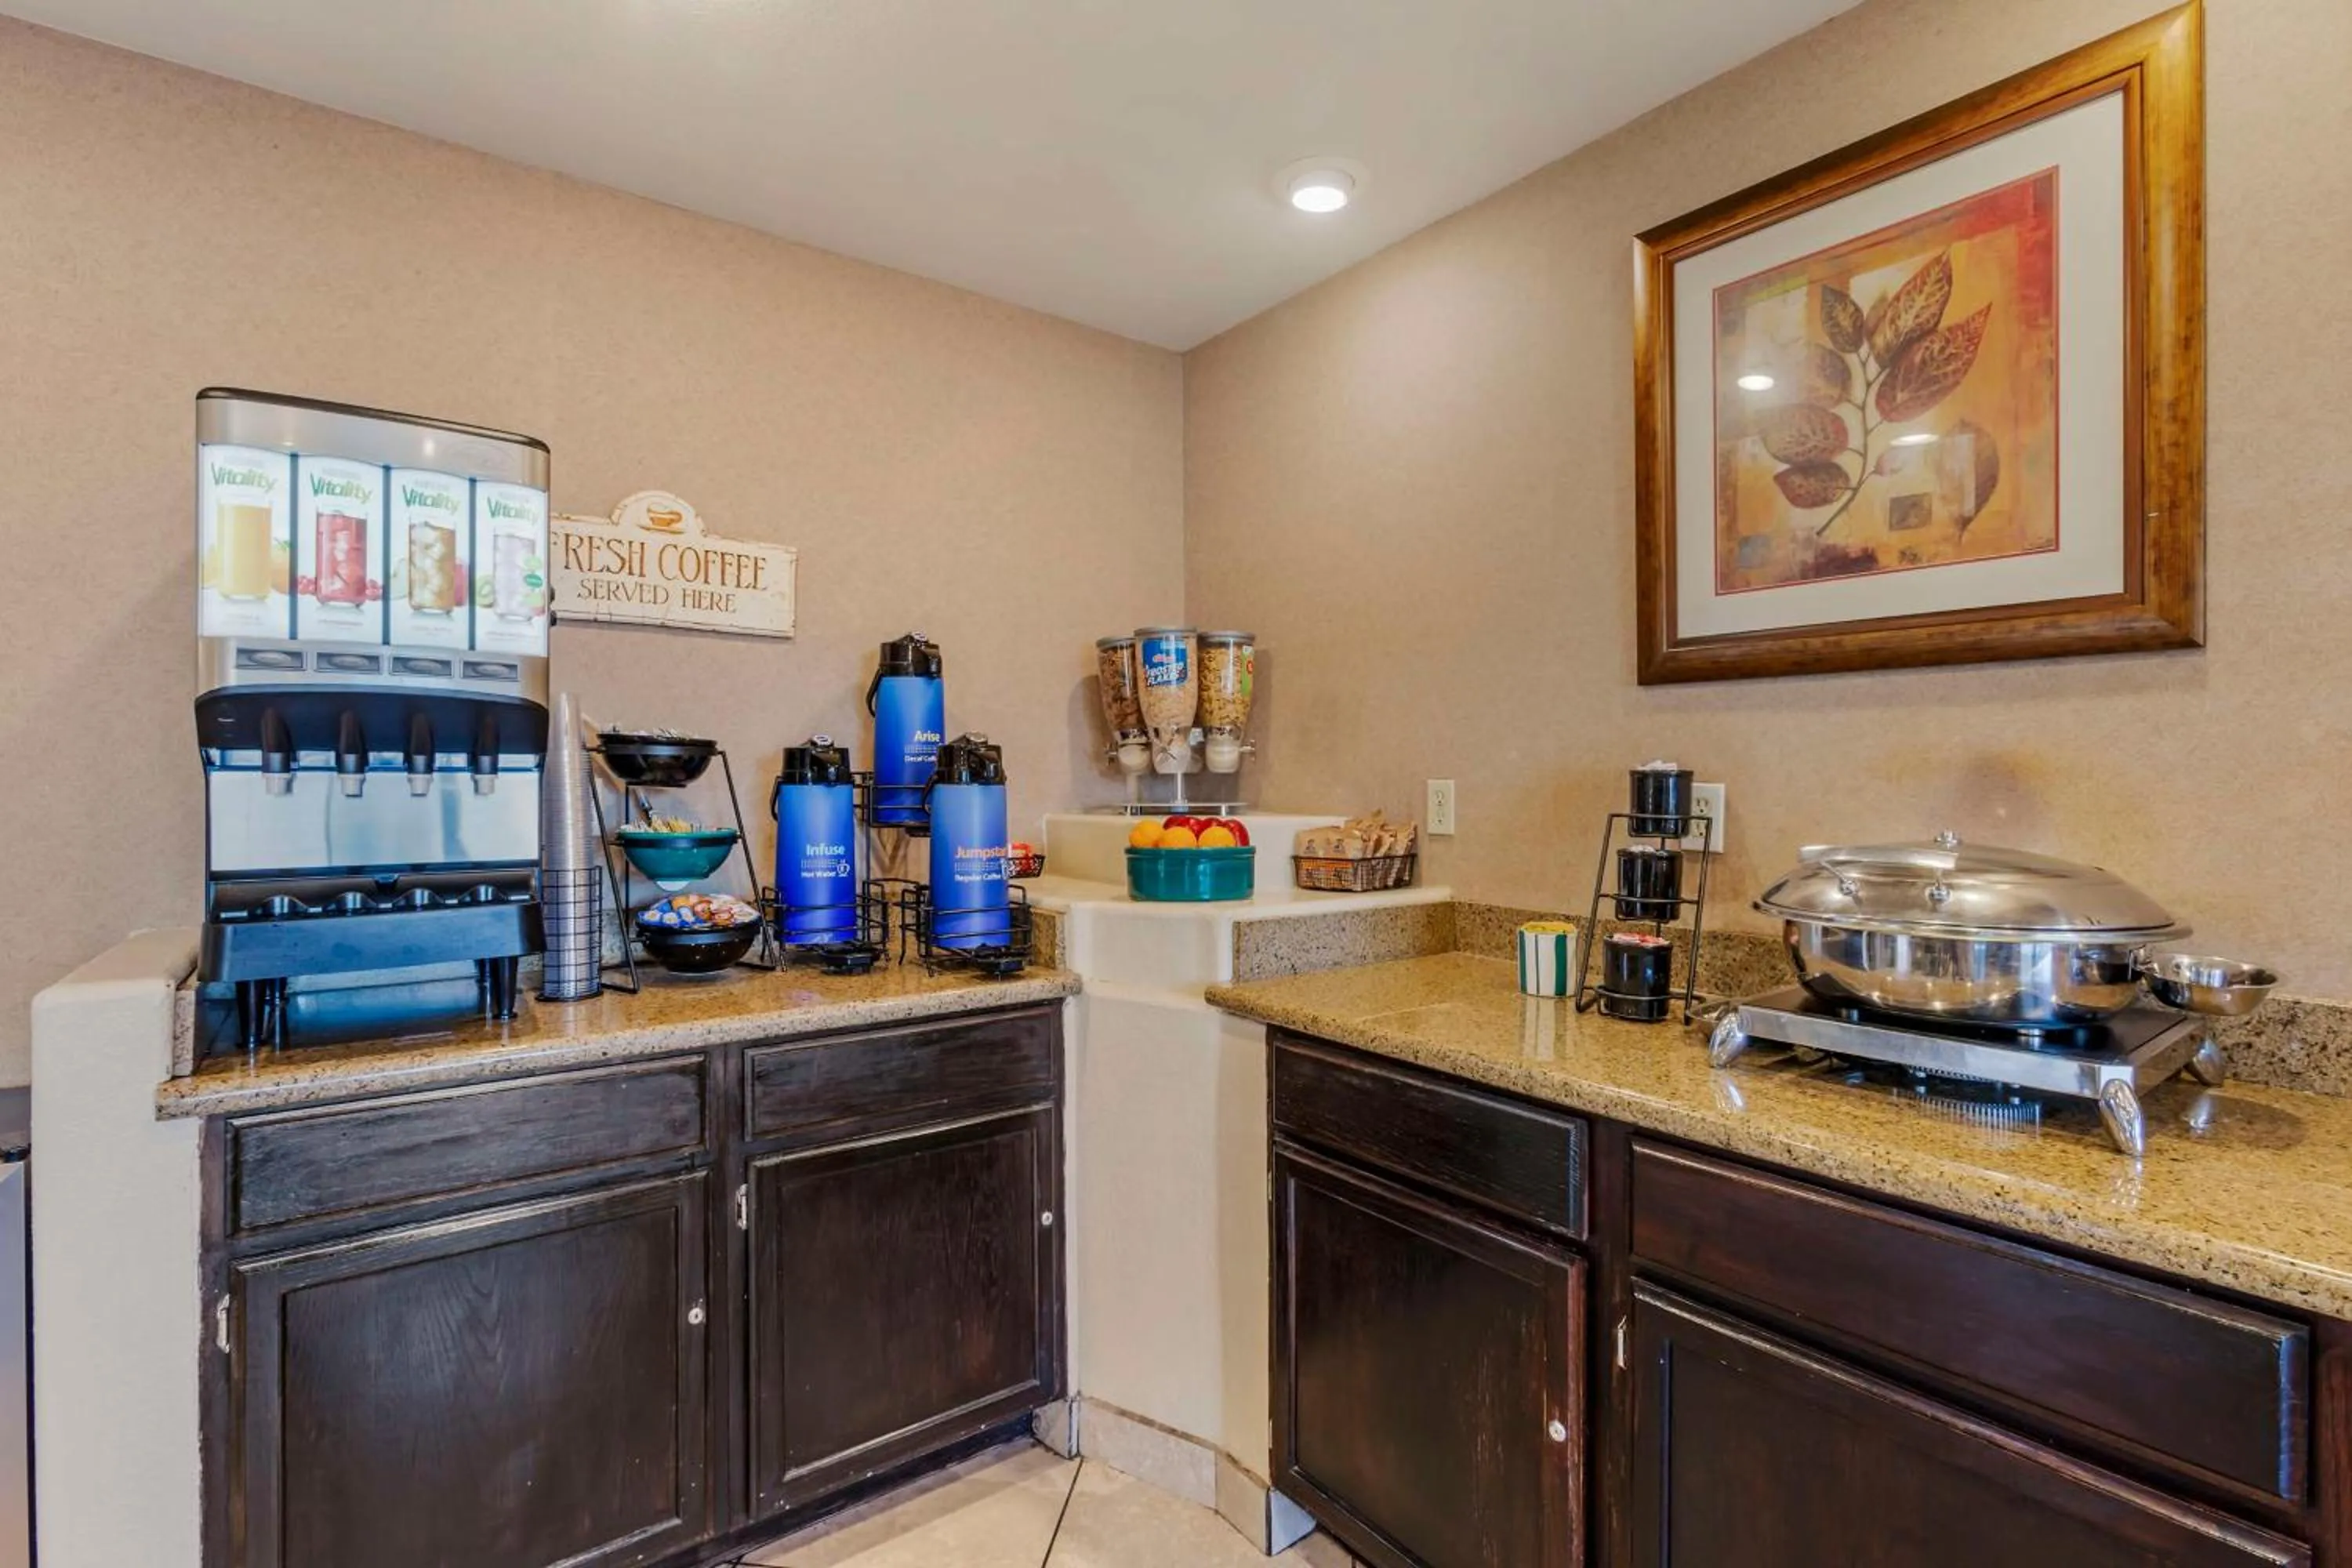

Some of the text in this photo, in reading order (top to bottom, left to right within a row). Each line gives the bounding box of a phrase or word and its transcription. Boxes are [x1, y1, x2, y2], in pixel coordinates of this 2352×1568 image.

[211, 462, 277, 494] Vitality
[310, 472, 373, 504] Vitality
[402, 485, 461, 516] Vitality
[487, 496, 539, 526] Vitality
[658, 544, 768, 591] COFFEE
[577, 578, 737, 614] SERVED HERE
[914, 730, 940, 742] Arise
[806, 843, 845, 856] Infuse
